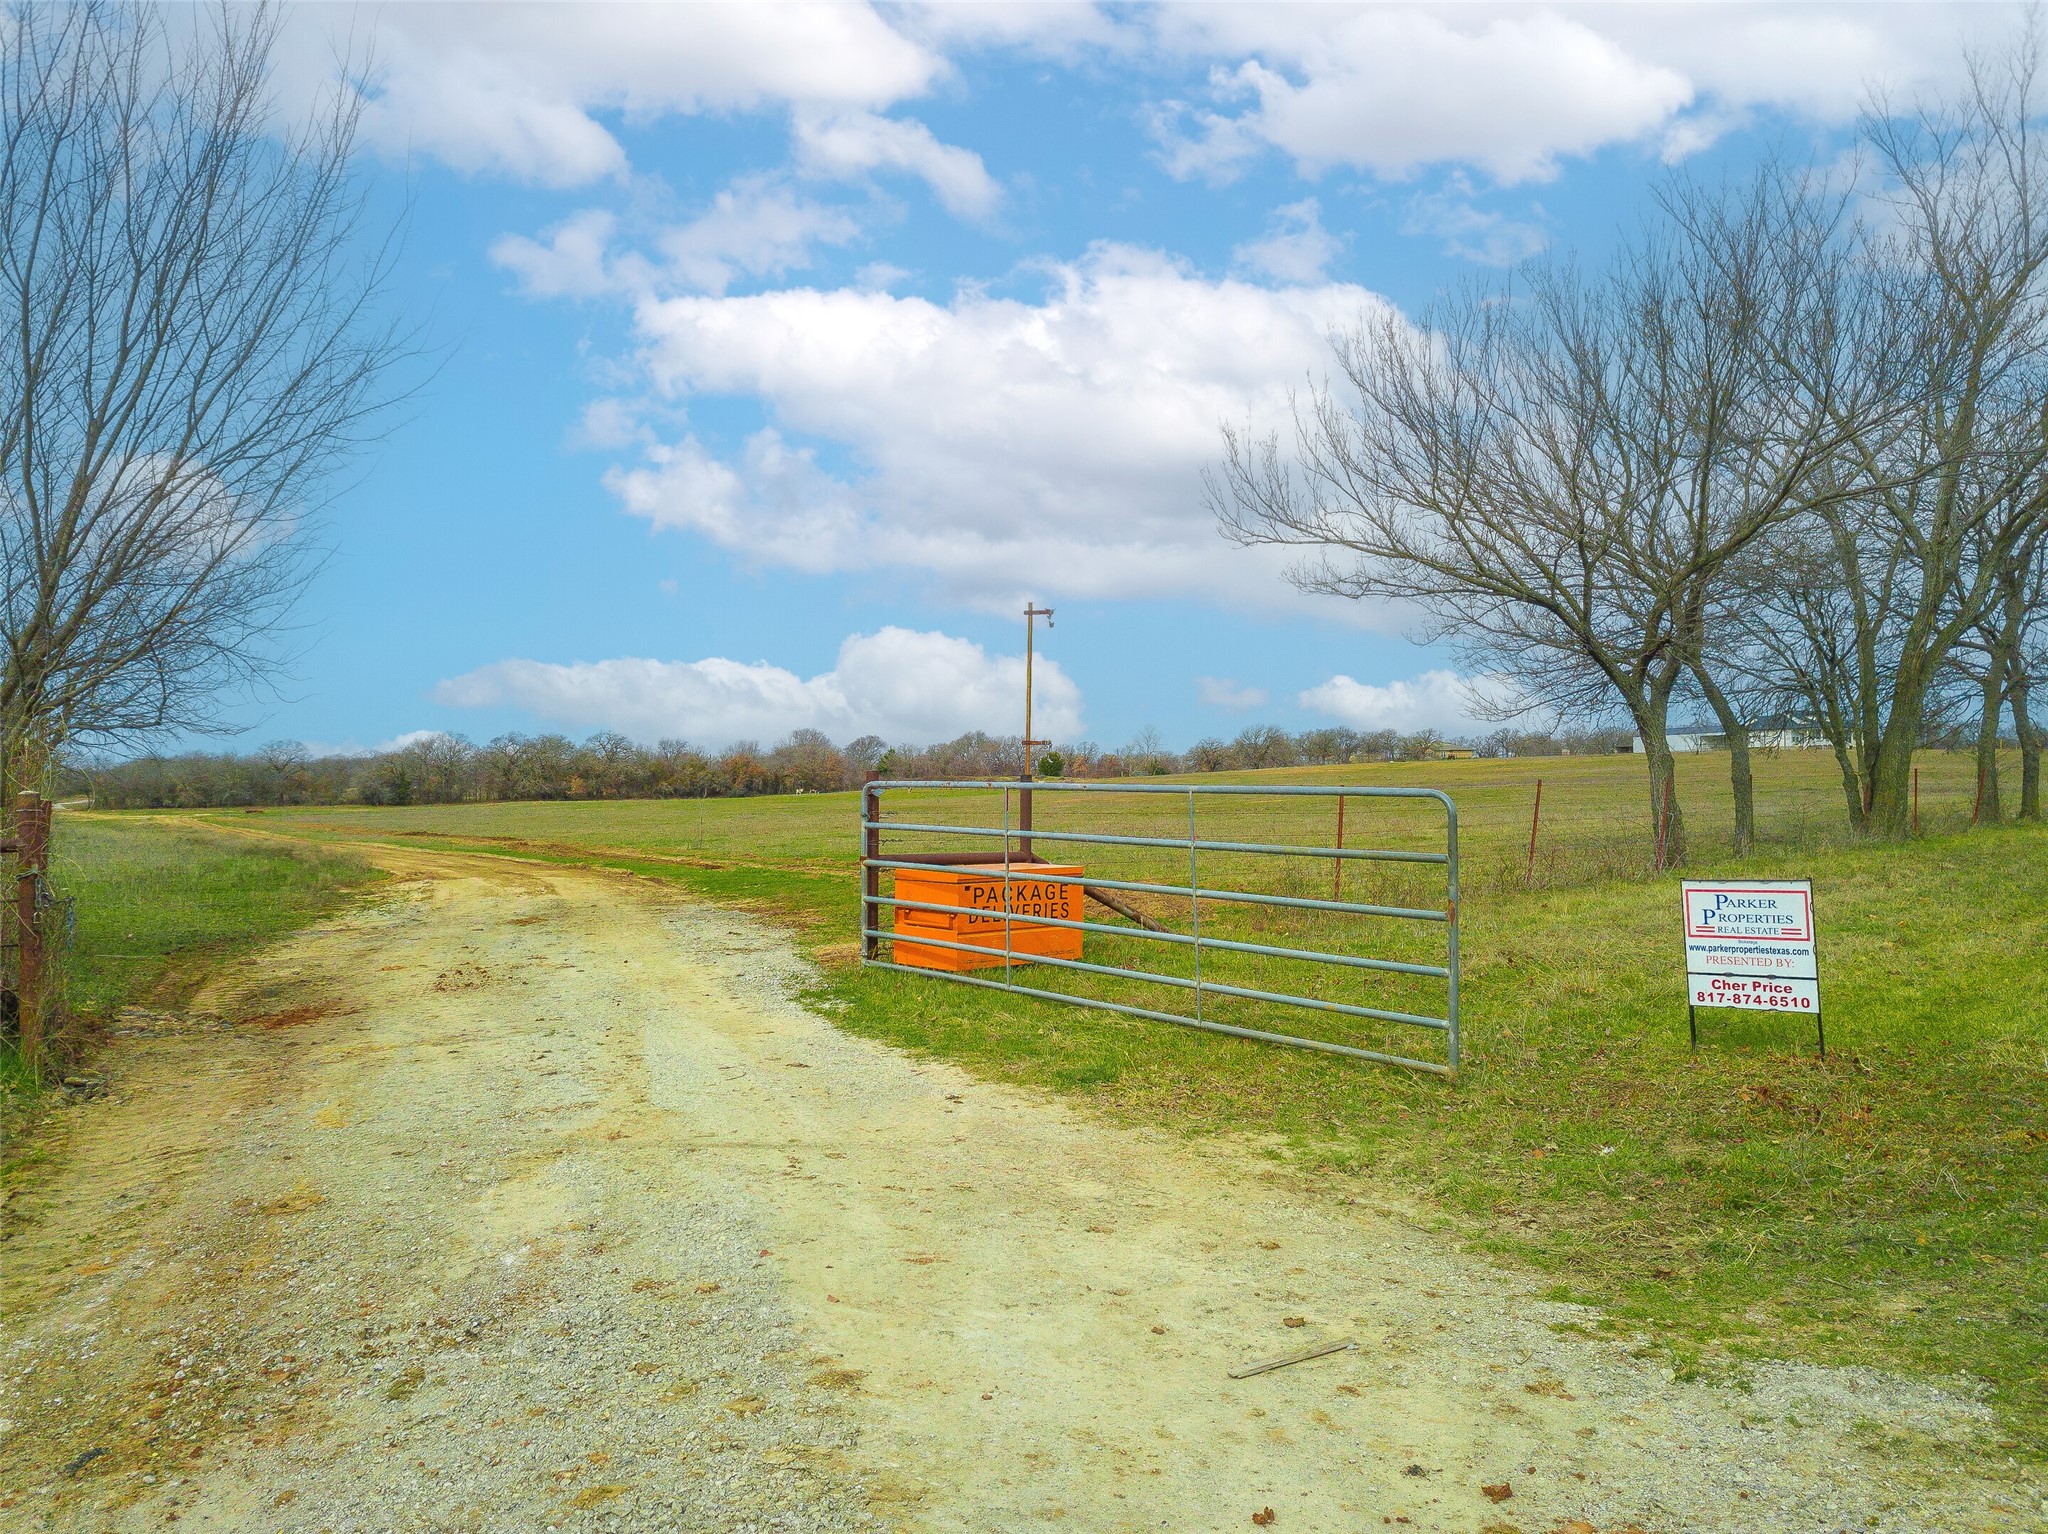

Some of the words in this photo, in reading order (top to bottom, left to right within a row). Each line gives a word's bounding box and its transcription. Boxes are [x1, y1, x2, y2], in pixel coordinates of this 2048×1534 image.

[973, 884, 1069, 903] PACKAGE
[1715, 894, 1777, 910] PARKER
[968, 902, 1069, 923] DELIVERIES
[1702, 909, 1793, 925] PROPERTIES
[1717, 926, 1742, 935] REAL
[1744, 927, 1780, 936] ESTATE
[1689, 944, 1809, 956] www.parkerpropertiestexas.com
[1706, 955, 1773, 967] PRESENTED
[1776, 958, 1795, 968] BY:
[1711, 979, 1747, 991] Cher
[1752, 981, 1793, 993] Price
[1697, 991, 1810, 1008] 817-874-6510
